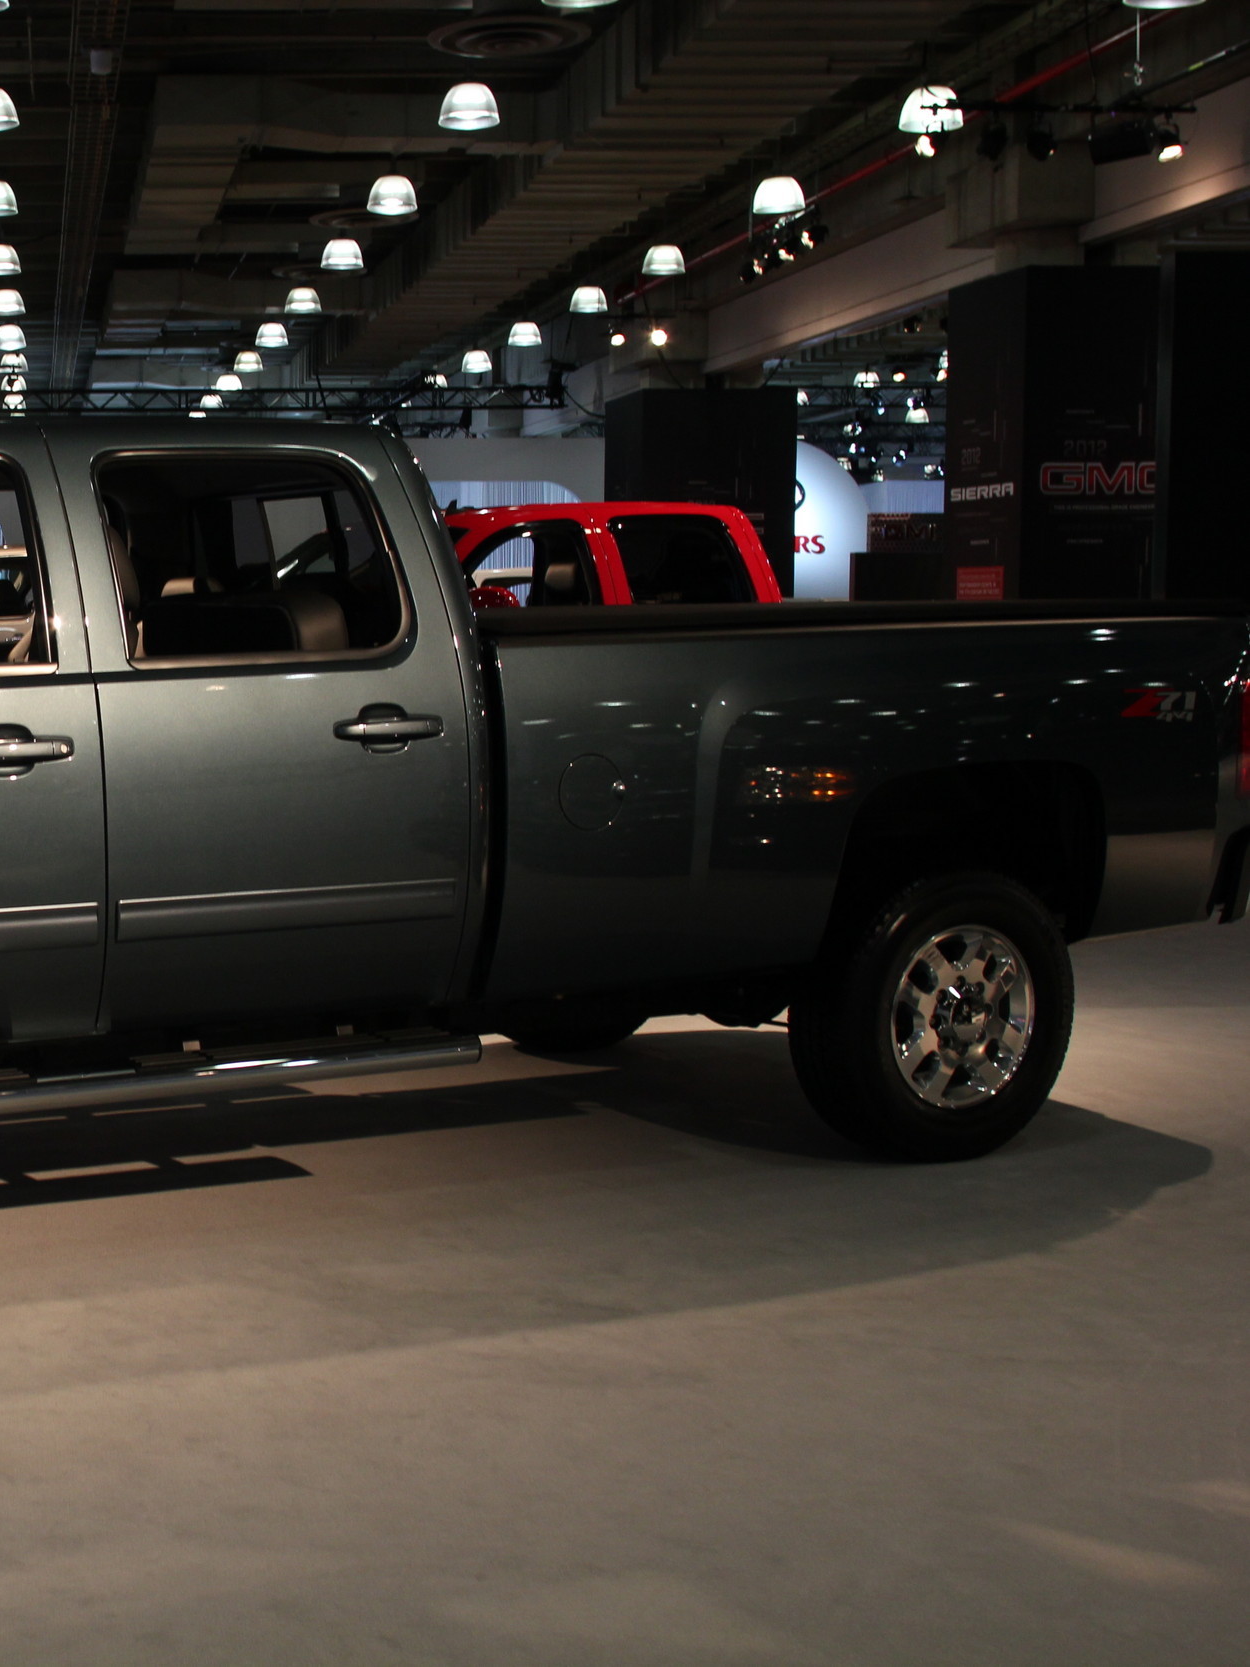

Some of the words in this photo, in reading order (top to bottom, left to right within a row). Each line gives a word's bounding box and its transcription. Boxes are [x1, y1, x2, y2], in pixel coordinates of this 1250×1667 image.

[960, 446, 981, 466] 2012
[1062, 439, 1107, 458] 2012
[950, 481, 1015, 502] SIERRA
[1120, 688, 1198, 718] Z71
